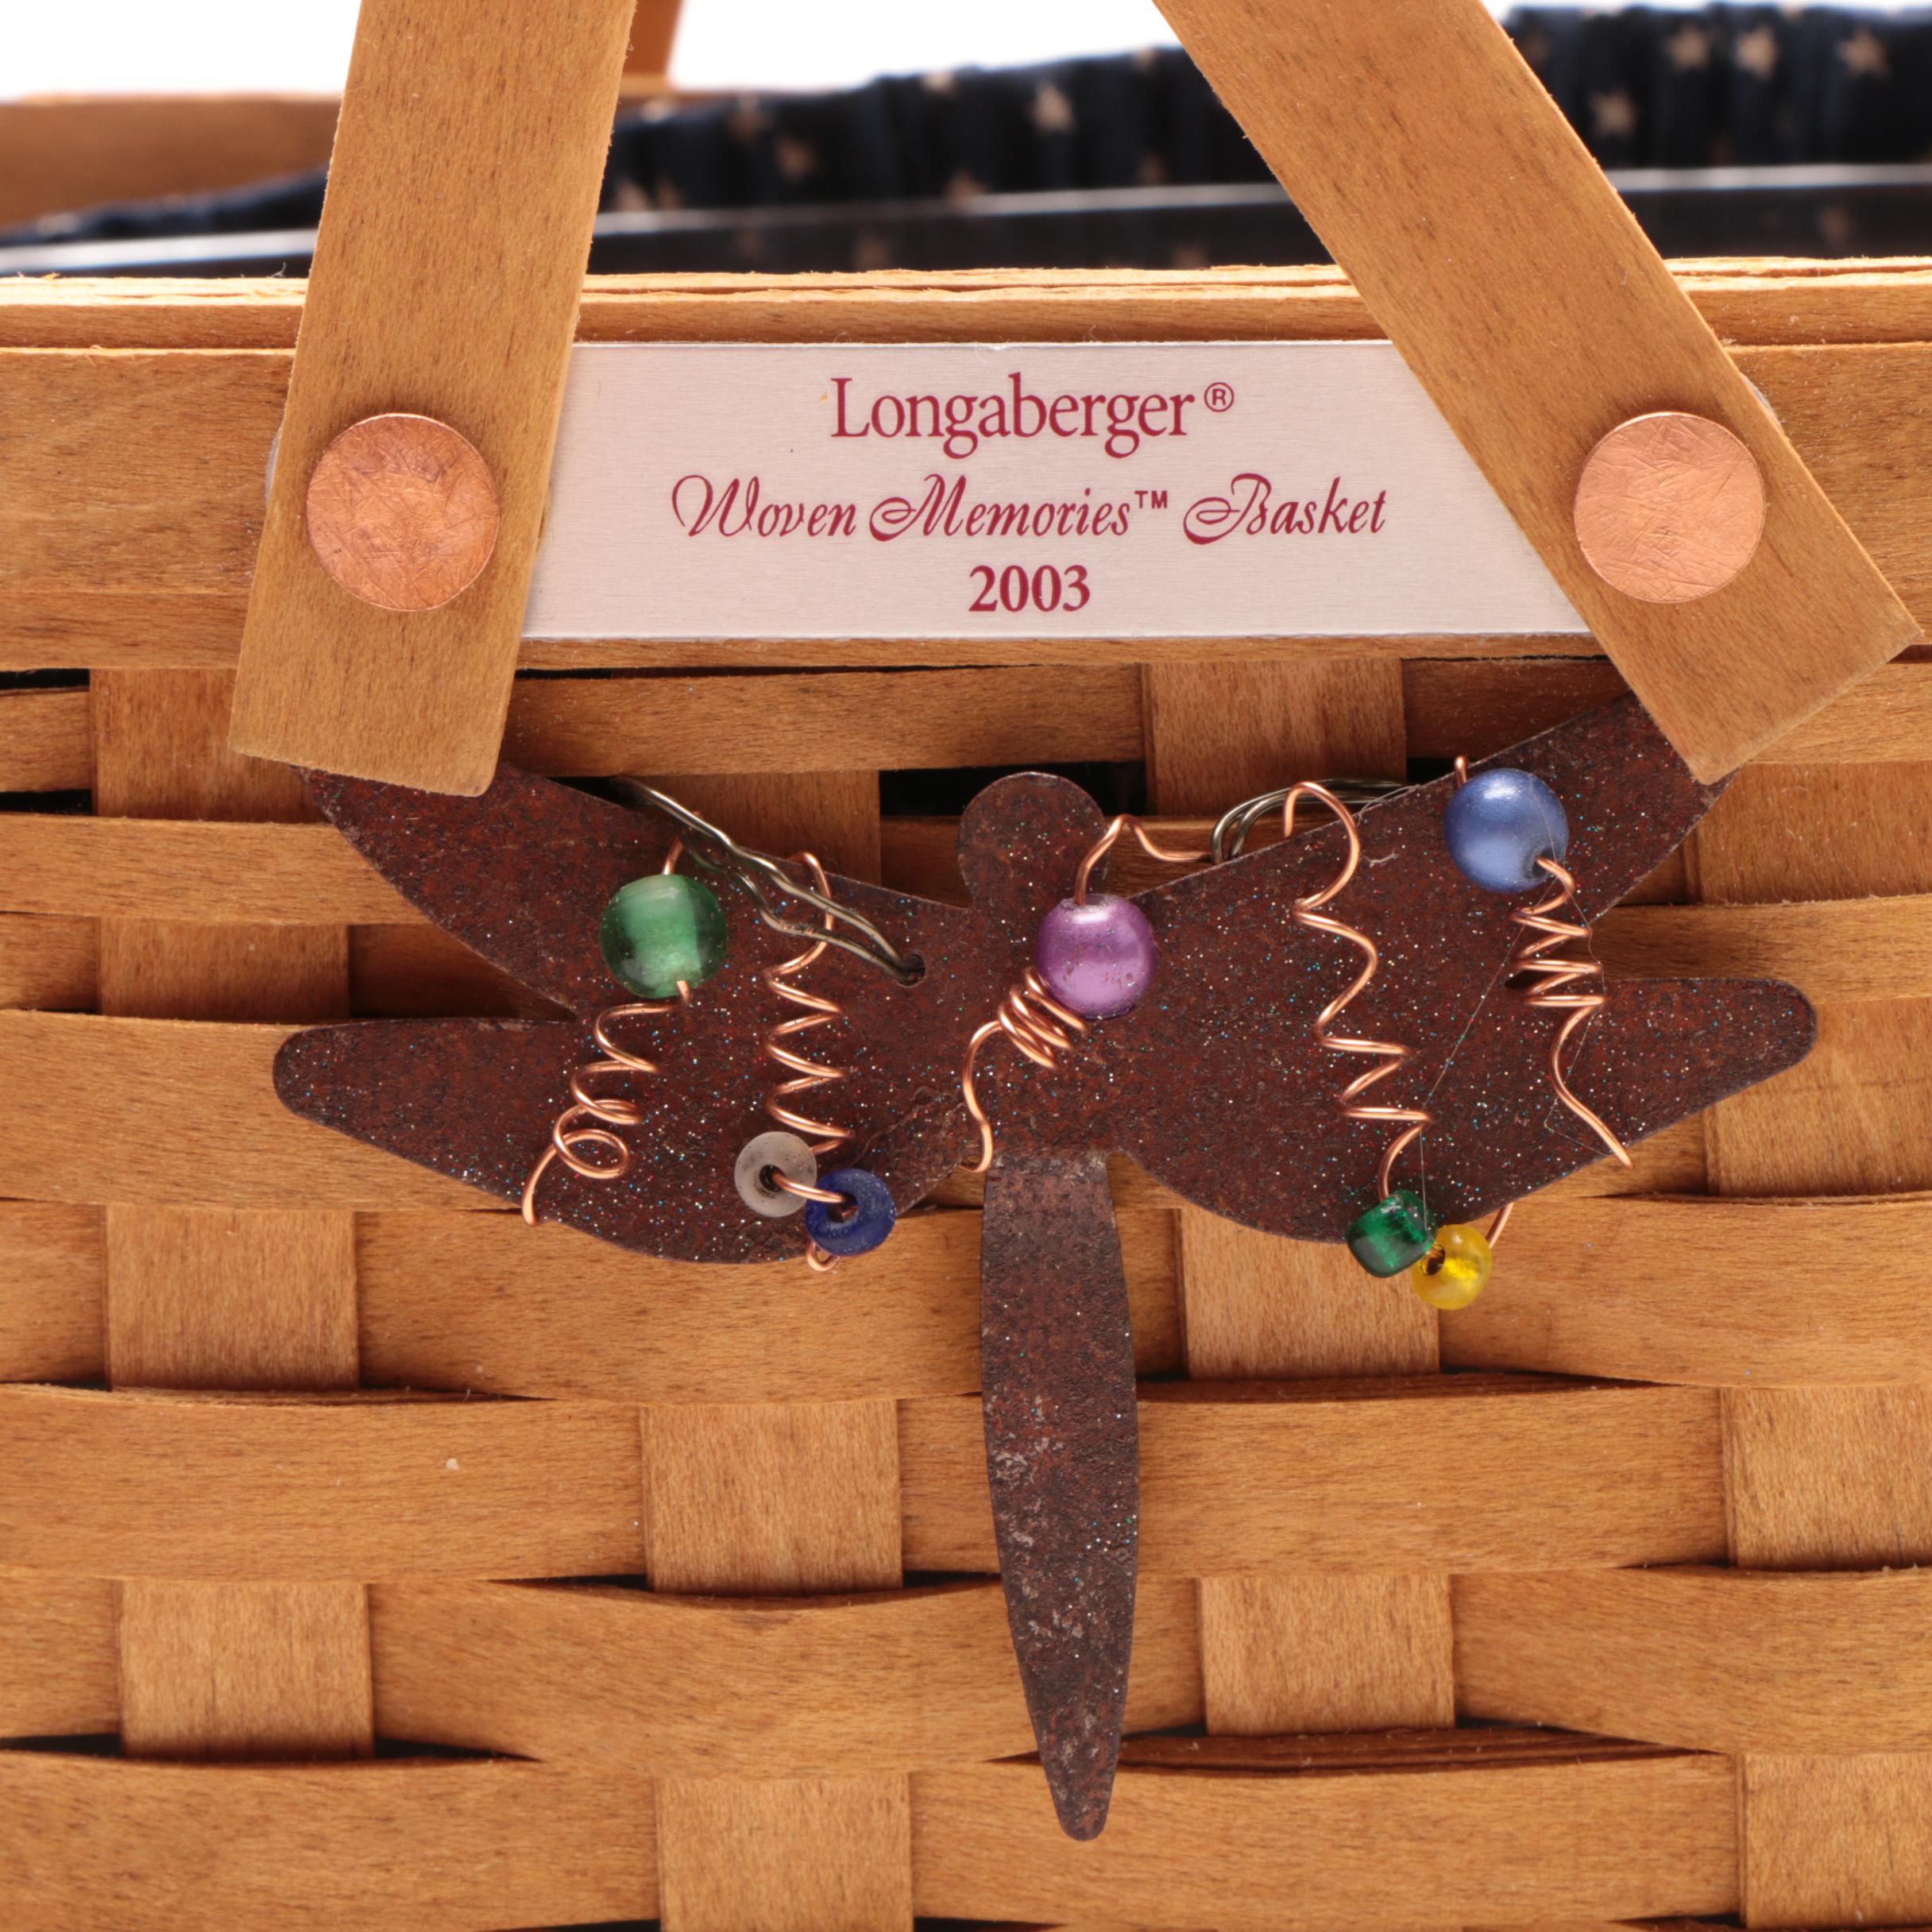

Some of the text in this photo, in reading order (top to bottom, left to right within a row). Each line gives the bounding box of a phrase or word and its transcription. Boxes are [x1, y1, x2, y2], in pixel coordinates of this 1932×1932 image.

[670, 473, 857, 538] Woven
[1182, 472, 1387, 546] Basket
[968, 564, 1091, 613] 2003
